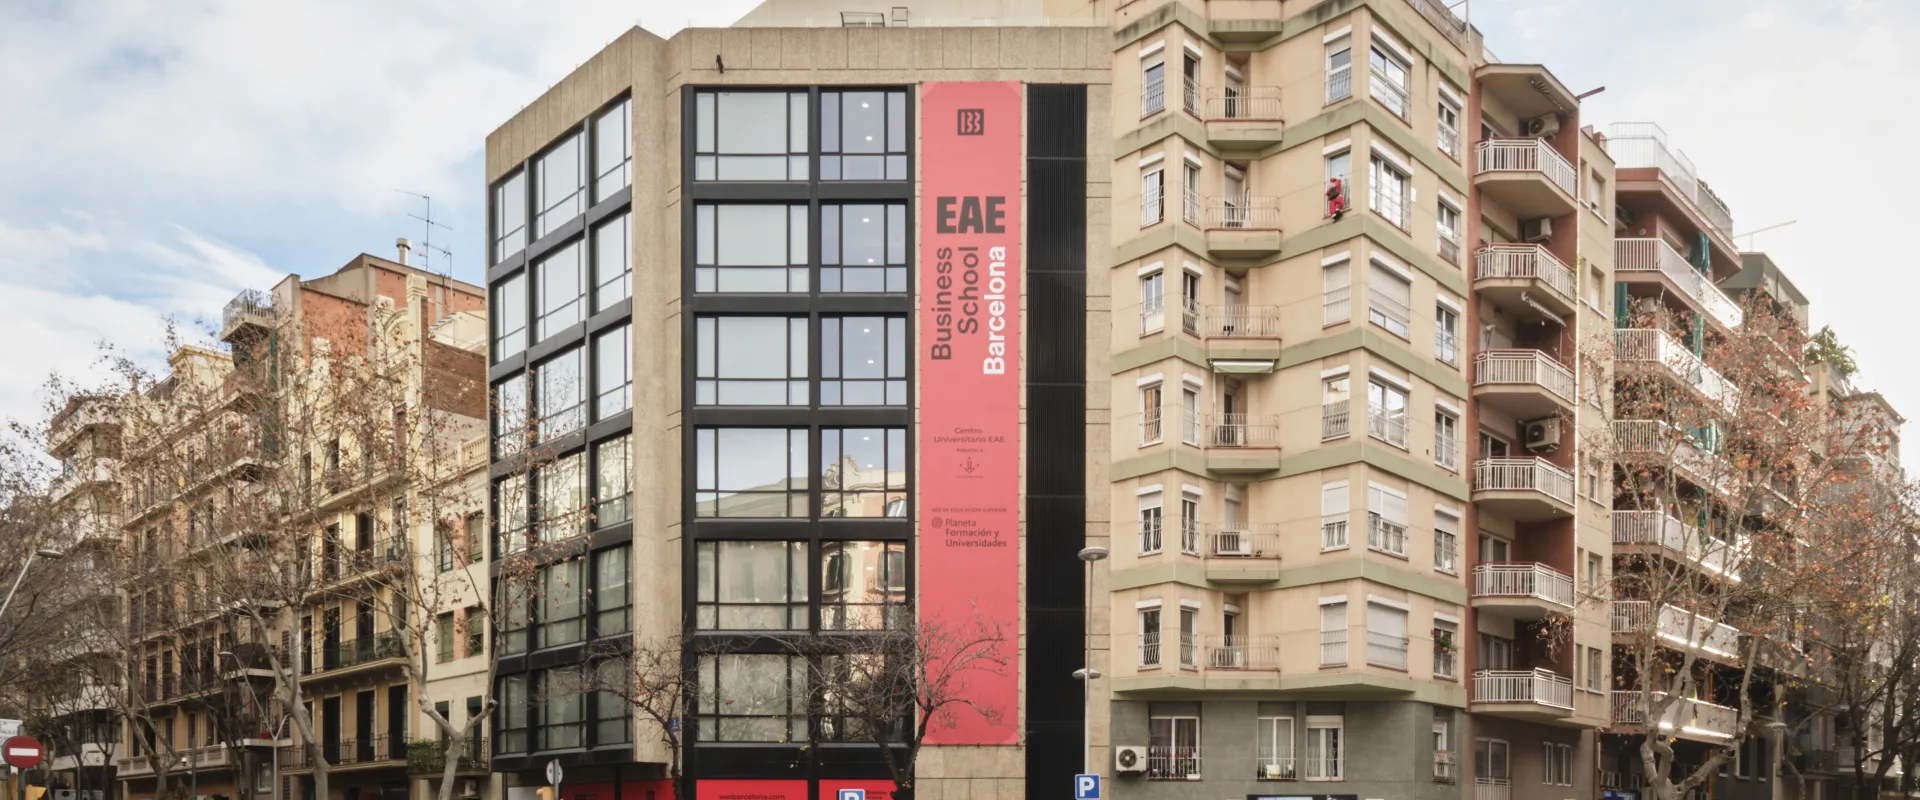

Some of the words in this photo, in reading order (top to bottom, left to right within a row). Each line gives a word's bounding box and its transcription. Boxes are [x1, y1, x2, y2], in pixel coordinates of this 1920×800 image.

[936, 196, 1006, 234] EAE
[930, 246, 953, 361] Business
[957, 246, 979, 335] School
[983, 246, 1006, 375] Barcelona
[954, 427, 983, 435] Centro
[945, 518, 977, 527] Planeta
[945, 528, 992, 537] Formación
[993, 530, 1000, 538] y
[1079, 777, 1095, 797] P
